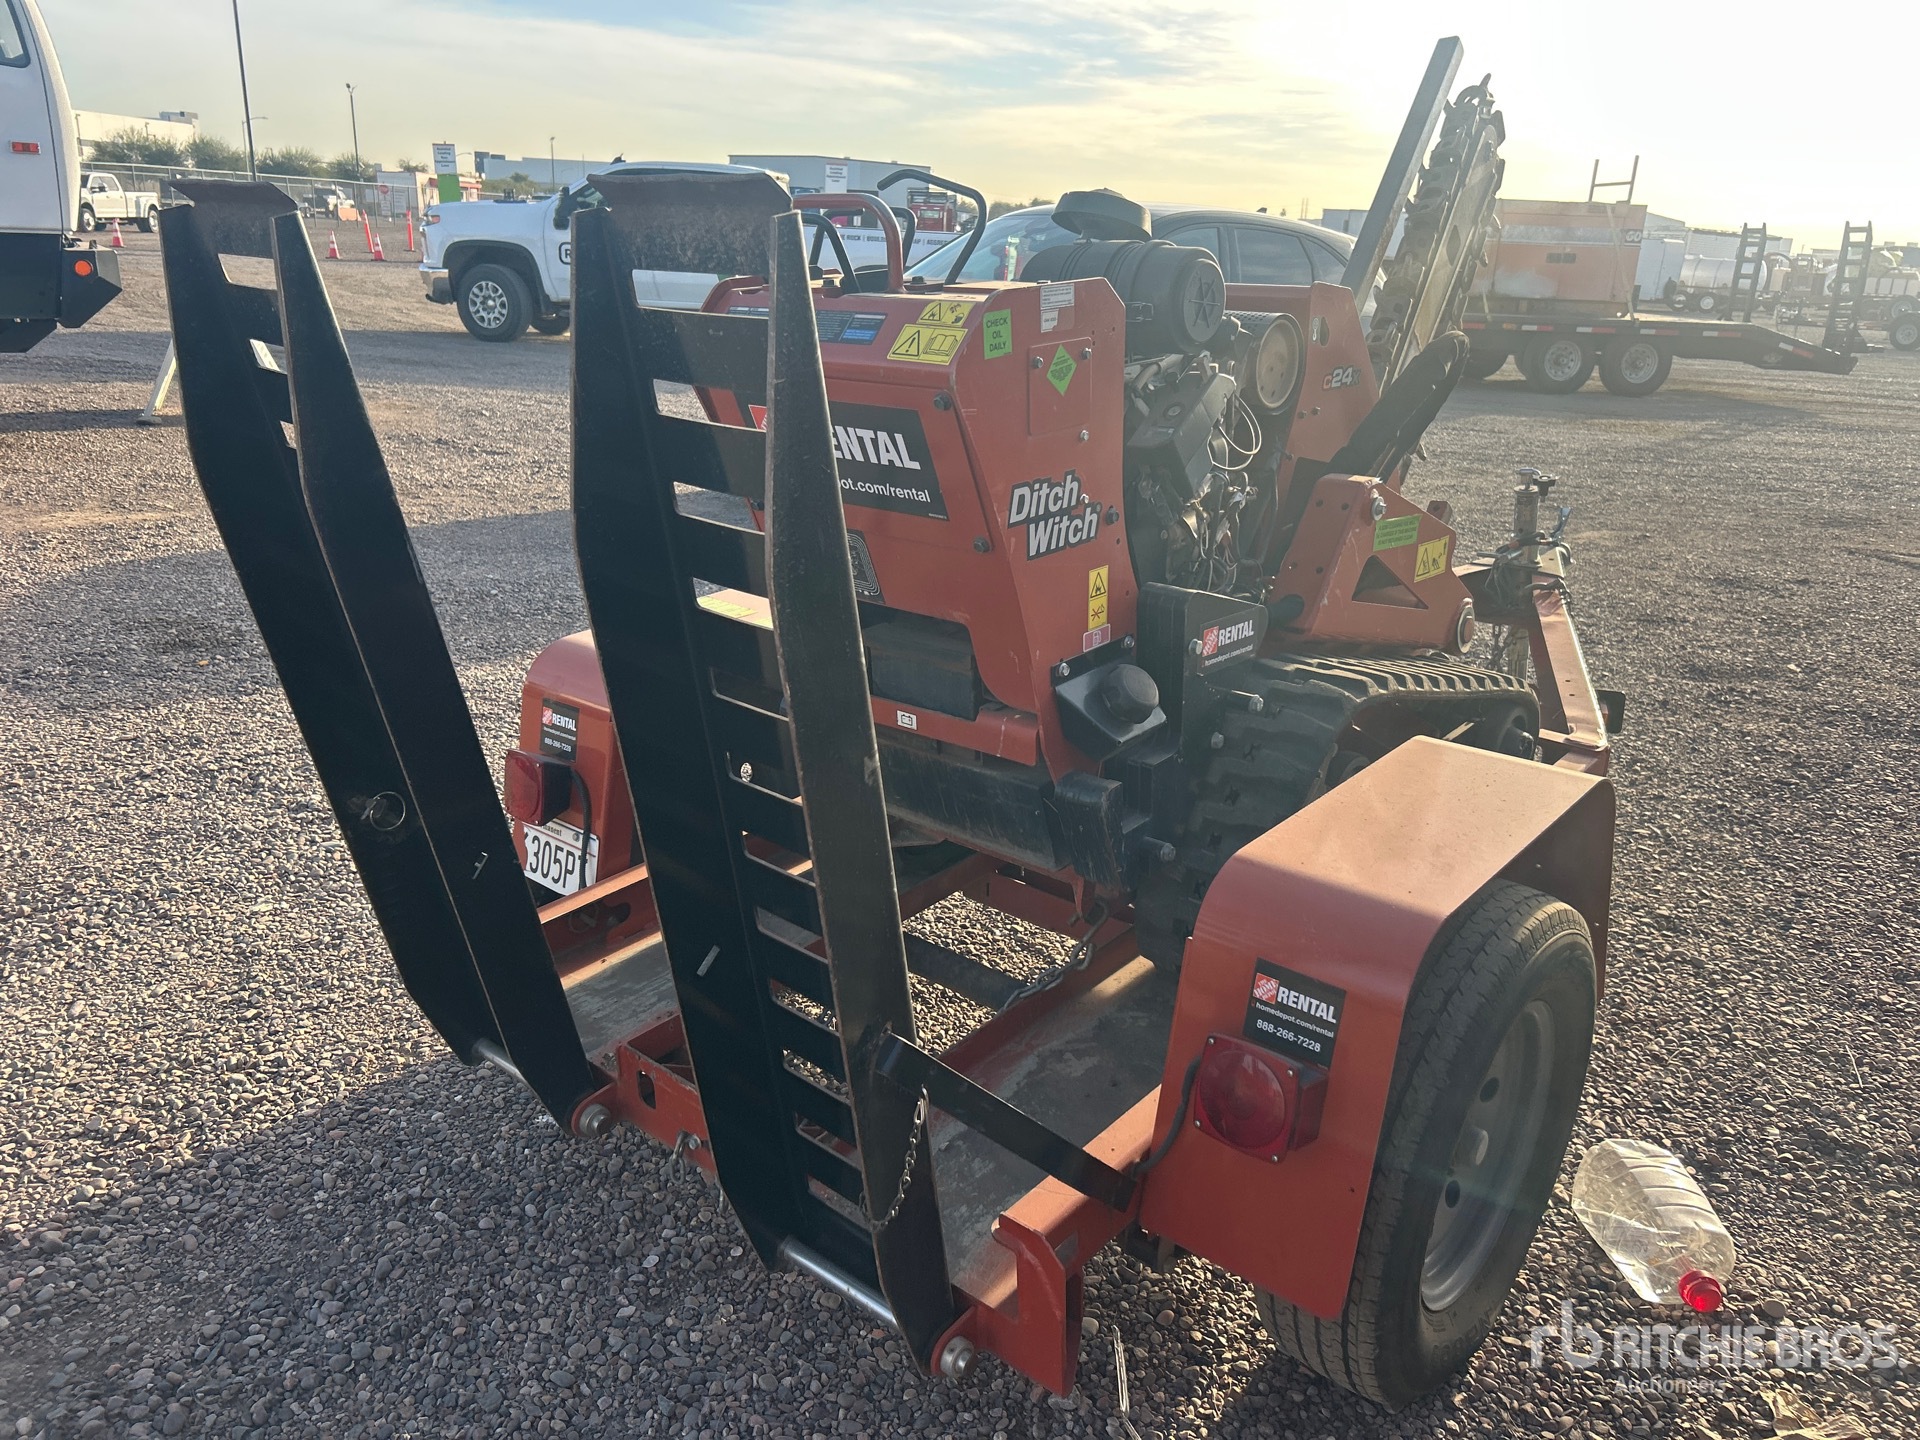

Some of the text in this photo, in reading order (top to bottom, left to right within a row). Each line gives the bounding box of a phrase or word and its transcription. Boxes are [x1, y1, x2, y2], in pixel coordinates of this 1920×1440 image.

[985, 317, 1008, 329] CHECK
[992, 331, 1003, 339] OIL
[989, 341, 1007, 352] DAILY
[831, 425, 922, 470] ENTAL
[839, 477, 931, 503] ot.com/rental
[1009, 474, 1079, 524] Ditch
[1029, 507, 1098, 557] Witch
[1218, 619, 1254, 647] RENTAL
[552, 712, 577, 731] RENTAL
[525, 831, 588, 889] 305P
[1255, 1001, 1335, 1038] homedepot.com/rental
[1276, 985, 1337, 1023] RENTAL
[1256, 1019, 1321, 1053] 888-266-7228
